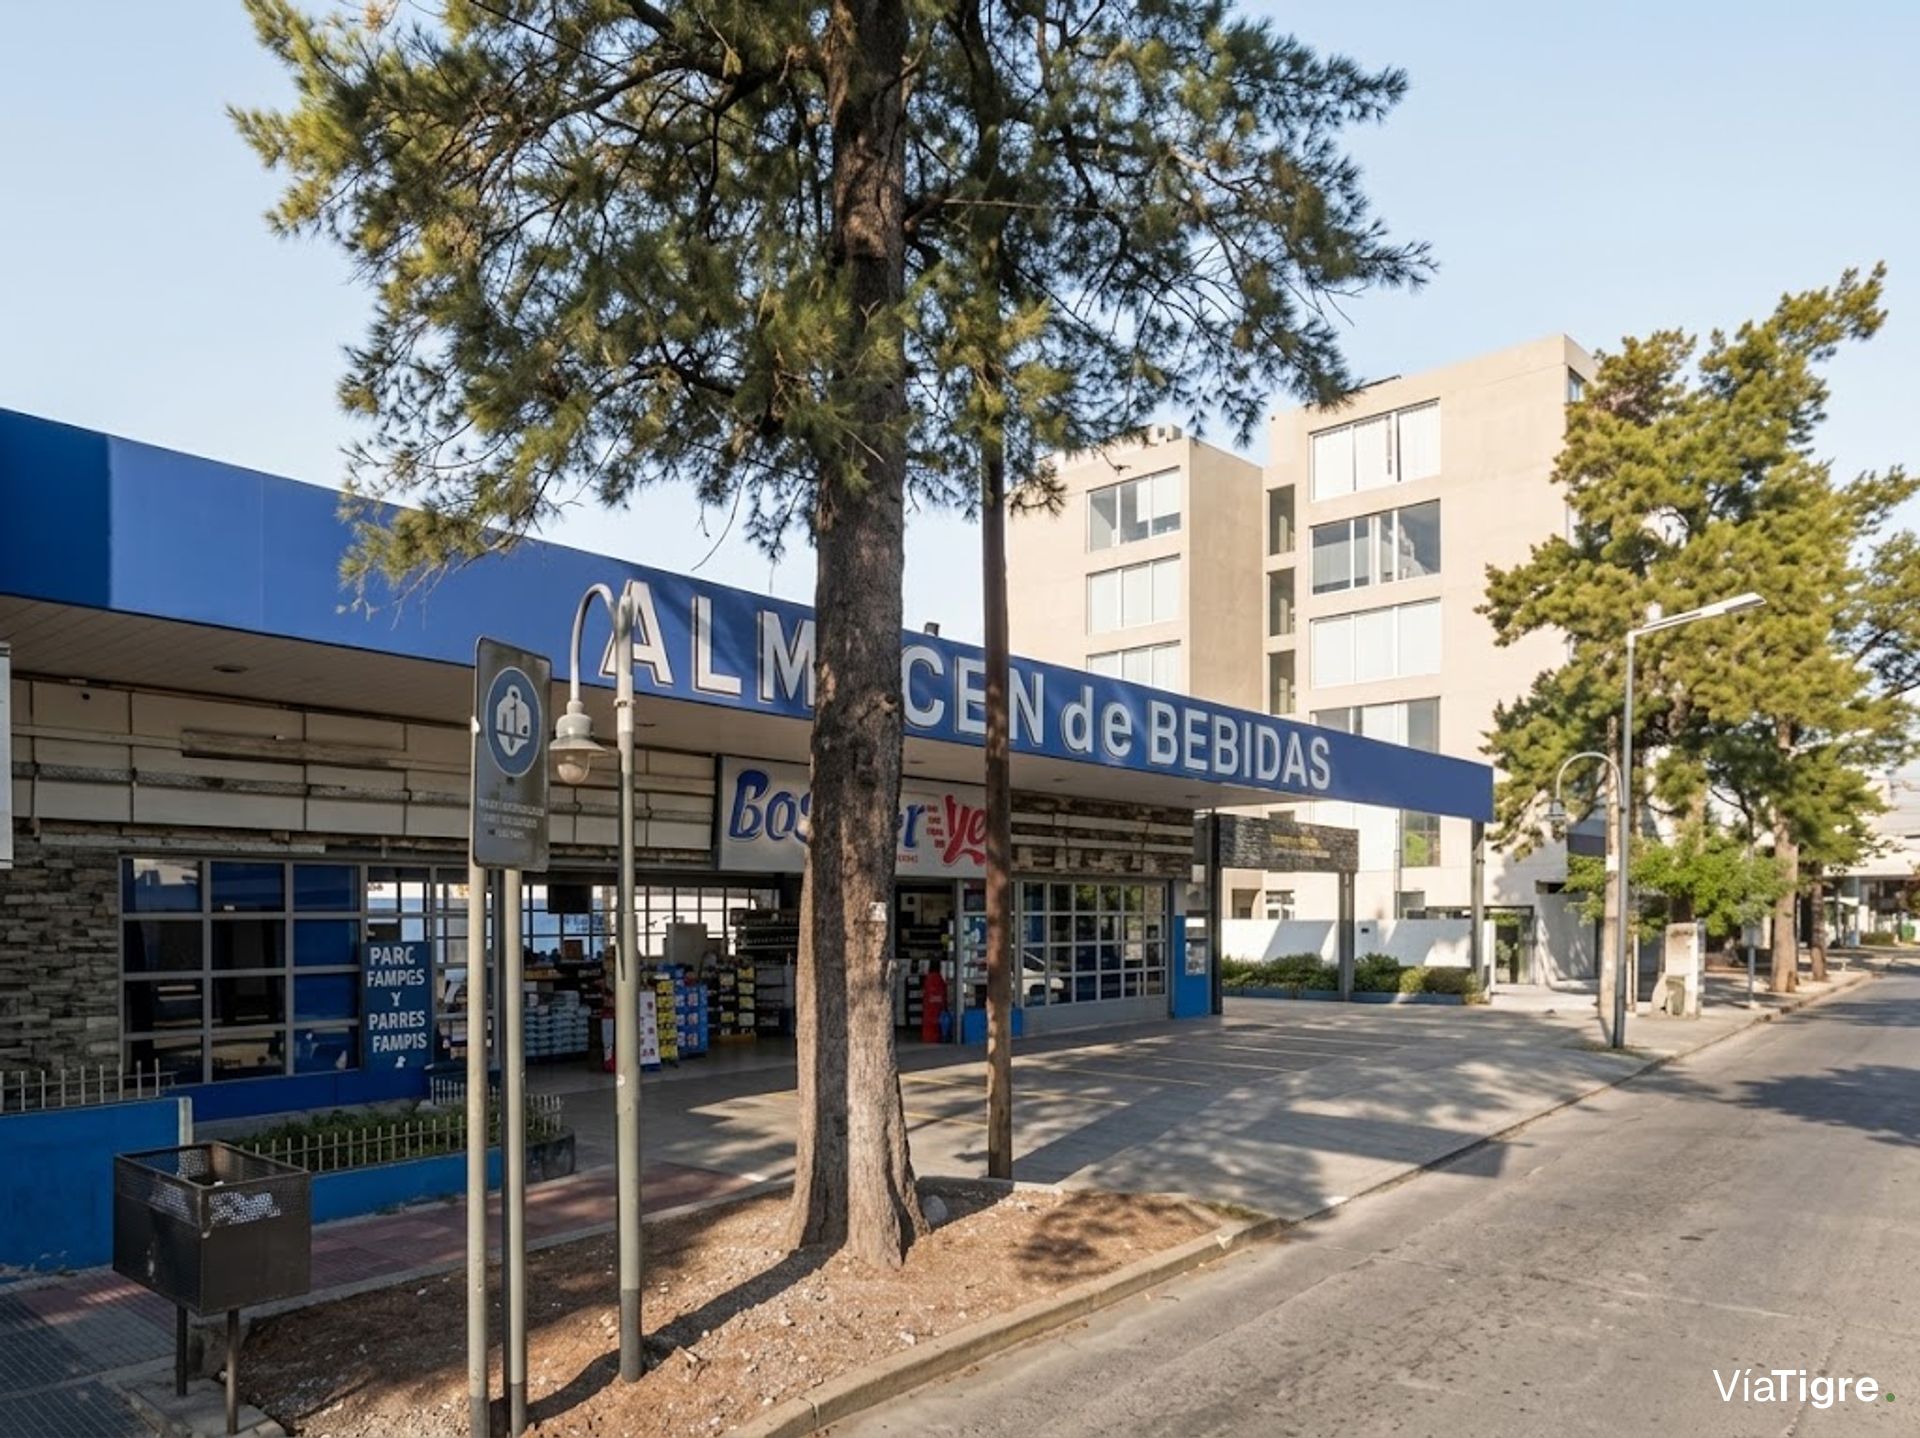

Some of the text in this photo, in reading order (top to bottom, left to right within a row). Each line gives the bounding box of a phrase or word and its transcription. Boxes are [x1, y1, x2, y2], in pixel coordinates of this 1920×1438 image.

[598, 579, 1331, 791] ALMCEN de BEBIDAS
[369, 946, 416, 966] PARC
[390, 991, 402, 1007] Y
[368, 1010, 426, 1031] PARRES
[372, 1032, 428, 1053] FAMPIS
